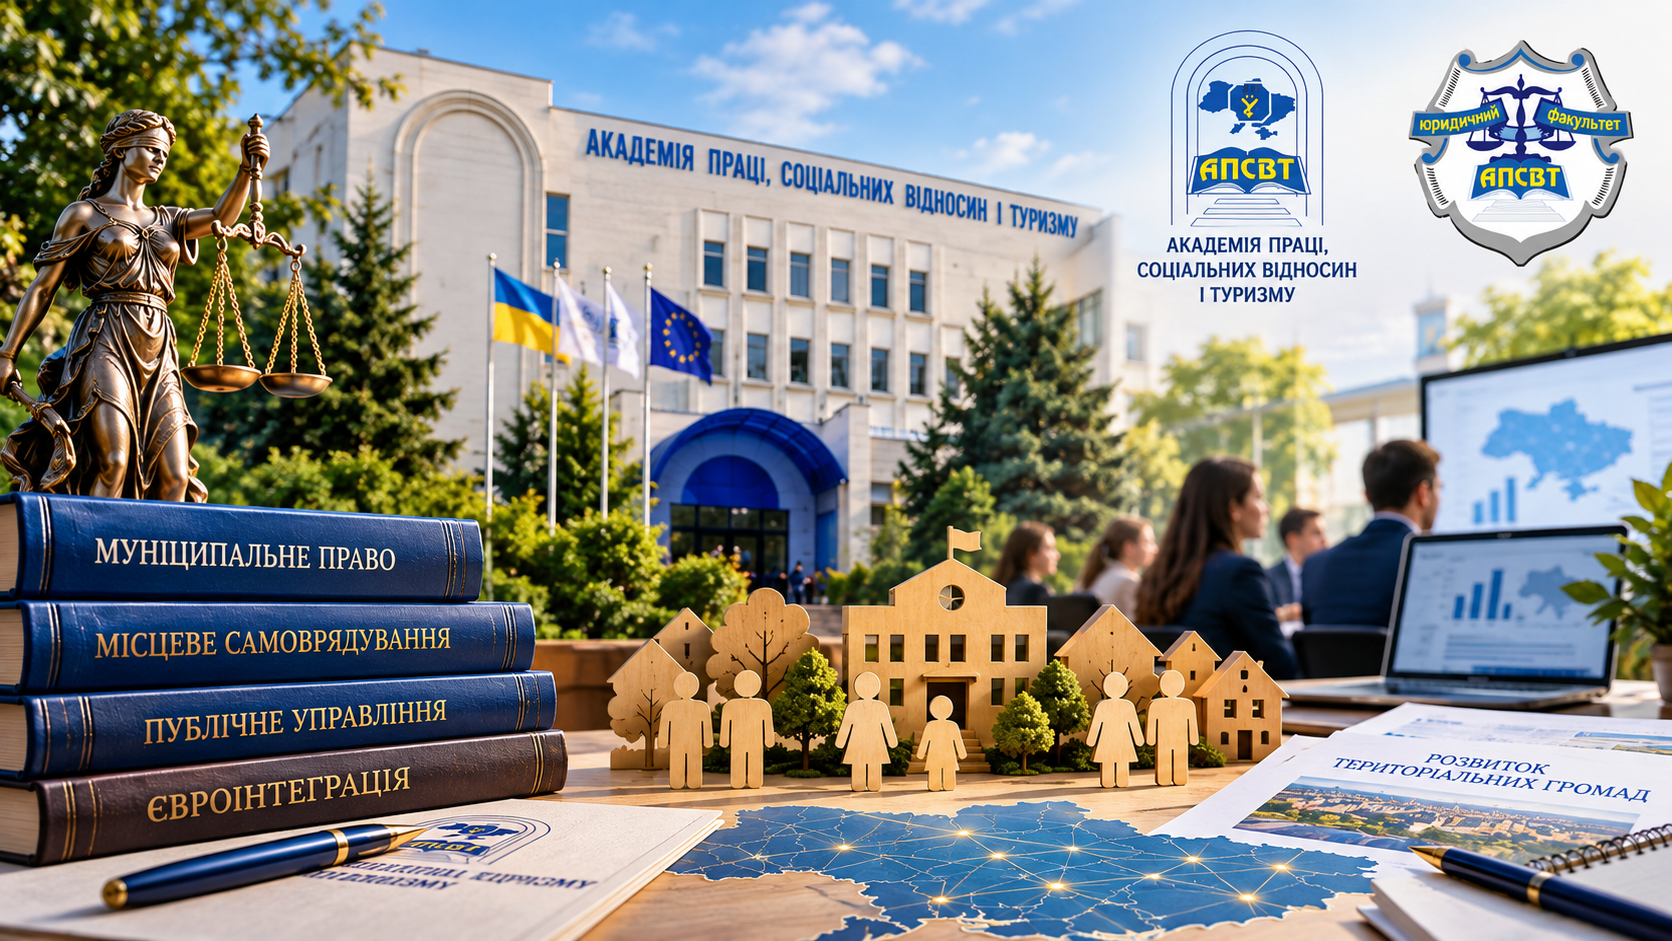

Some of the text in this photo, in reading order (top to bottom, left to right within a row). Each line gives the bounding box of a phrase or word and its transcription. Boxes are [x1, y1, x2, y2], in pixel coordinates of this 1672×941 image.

[586, 128, 1079, 239] АКАДЕМІЯ ПРАЦІ, СОЦІАЛЬНИХ ВІДНОСИН І ТУРИЗМУ
[94, 537, 396, 571] МУНІЦИПАЛЬНЕ ПРАВО
[95, 627, 451, 661] МІСЦЕВЕ САМОВРЯДУВАННЯ
[144, 699, 447, 745] ПУБЛІЧНЕ УПРАВЛІННЯ
[1333, 757, 1651, 804] ТЕРИТОРІАЛЬНИХ ГРОМАД
[1425, 753, 1551, 775] РОЗВИТОК
[147, 766, 411, 823] ЄВРОІНТЕГРАЦІЯ
